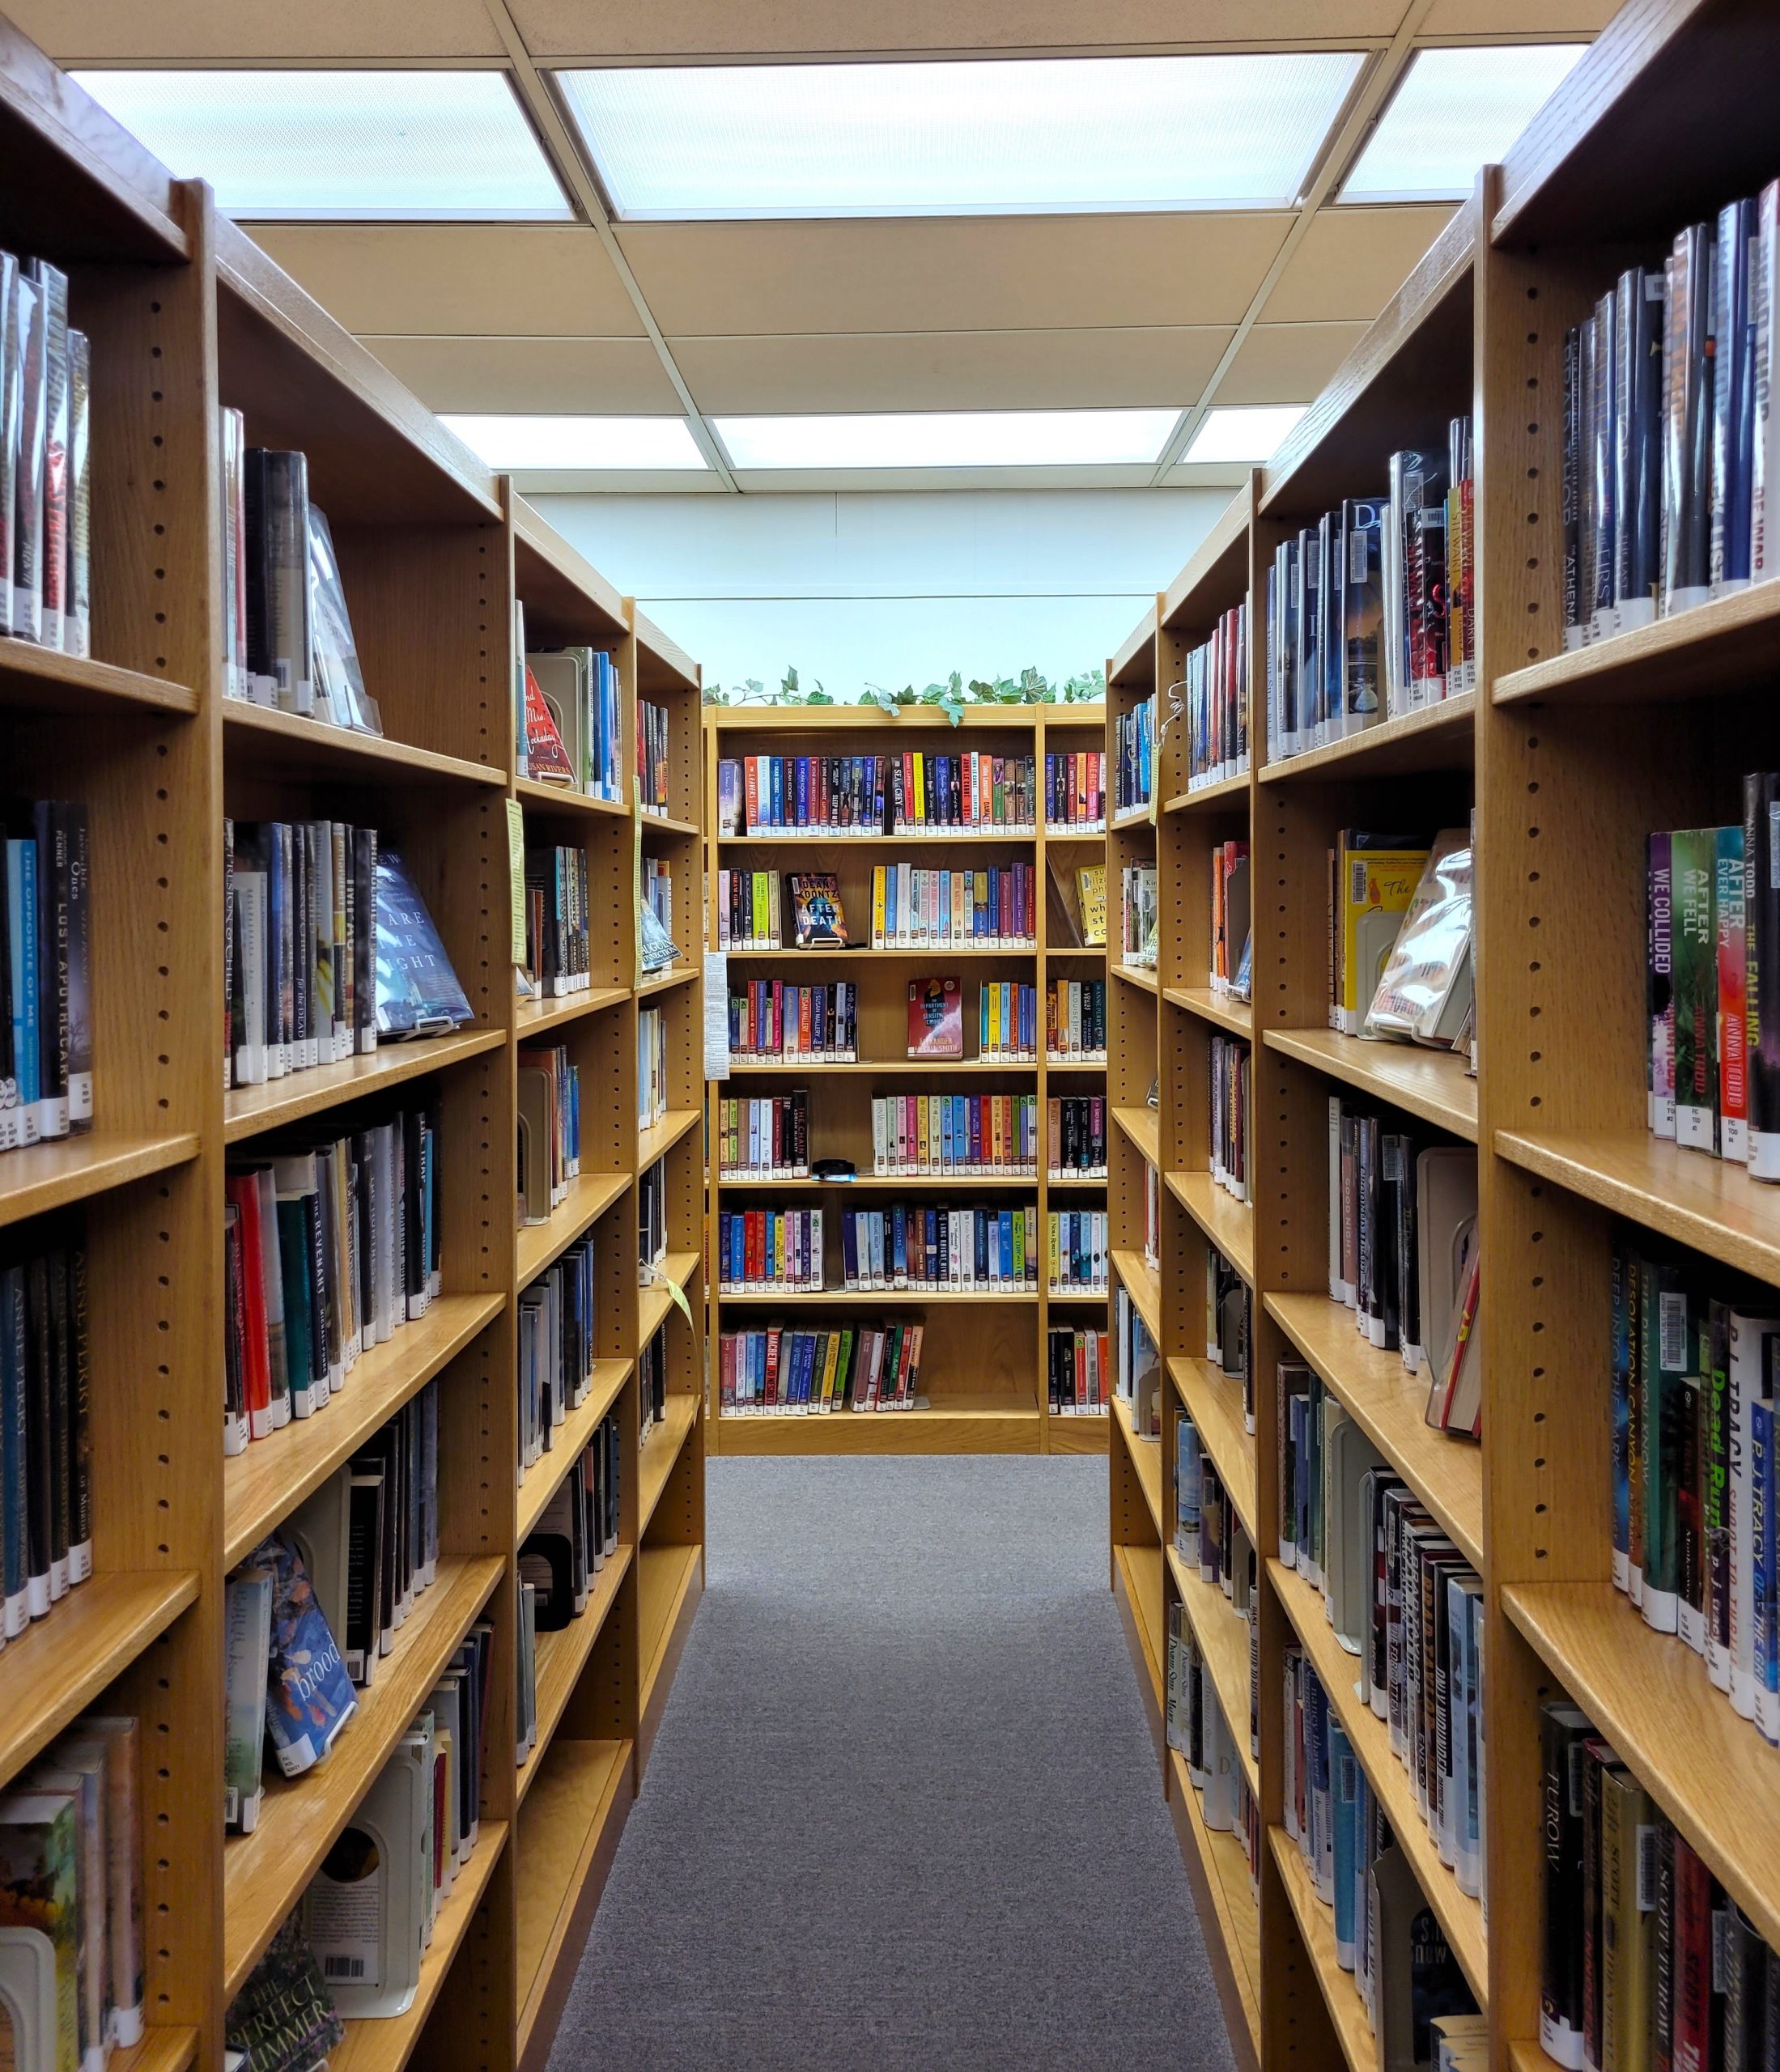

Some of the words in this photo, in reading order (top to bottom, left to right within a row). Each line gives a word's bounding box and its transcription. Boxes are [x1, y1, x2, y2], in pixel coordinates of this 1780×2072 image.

[1710, 524, 1723, 584] LIST
[1753, 519, 1764, 571] WAR
[1567, 557, 1576, 624] ATHENA
[1621, 558, 1629, 589] LAST
[526, 707, 546, 723] Mrs.
[546, 765, 570, 774] RIVERS
[71, 861, 81, 900] Ones
[79, 827, 87, 889] Invisible
[1654, 868, 1668, 894] WE
[1684, 869, 1695, 890] WE
[1718, 859, 1727, 894] EVER
[1746, 860, 1755, 898] TODD
[801, 904, 839, 913] AFTER
[1384, 879, 1411, 896] The
[1698, 870, 1708, 944] AFTER
[1730, 860, 1744, 928] AFTER
[57, 903, 67, 948] LOST
[389, 911, 424, 926] ARE
[803, 916, 841, 925] DEATH
[1655, 898, 1669, 973] COLLIDED
[1684, 894, 1696, 936] FELL
[1718, 899, 1729, 948] HAPPY
[1746, 923, 1756, 949] THE
[26, 978, 33, 996] OF
[1746, 959, 1759, 1046] FALLING
[28, 1004, 34, 1026] ME
[59, 962, 69, 1085] APOTHECARY
[1694, 1006, 1705, 1049] ANNA
[1727, 1015, 1742, 1058] ANNA
[1695, 1053, 1706, 1093] TODD
[1728, 1063, 1742, 1106] TODD
[315, 1220, 325, 1295] REVENANT
[347, 1227, 355, 1286] widows
[76, 1253, 87, 1326] ANNE
[1612, 1258, 1621, 1308] DEEP
[768, 1335, 777, 1365] MACBETH
[1612, 1313, 1621, 1368] INTO
[1642, 1319, 1650, 1372] DEVIL
[78, 1335, 88, 1417] PERRY
[1612, 1374, 1621, 1405] THE
[1642, 1378, 1650, 1420] YOU
[1710, 1369, 1725, 1453] Dead
[1612, 1414, 1621, 1468] DARK
[1629, 1394, 1637, 1484] CANYON
[1642, 1425, 1650, 1484] KNOW
[1709, 1463, 1725, 1527] Run
[1752, 1483, 1763, 1566] TRACY
[1423, 1576, 1433, 1637] BRAD
[1753, 1573, 1764, 1610] OFF
[1390, 1624, 1399, 1645] THE
[1711, 1598, 1720, 1640] tracy
[1754, 1613, 1765, 1646] THE
[292, 1632, 341, 1701] brood
[1251, 1669, 1256, 1679] TO
[1389, 1647, 1399, 1716] FORGOTTEN
[1425, 1644, 1434, 1730] TAYLOR
[1436, 1668, 1446, 1704] ONLY
[1311, 1688, 1319, 1730] nancy
[1313, 1734, 1321, 1781] thayer
[1437, 1707, 1446, 1773] WOUNDED
[1546, 1771, 1559, 1871] TUROW
[1314, 1840, 1322, 1875] cottage
[229, 1972, 314, 2047] PERFECT
[1658, 1953, 1669, 2043] TUROW
